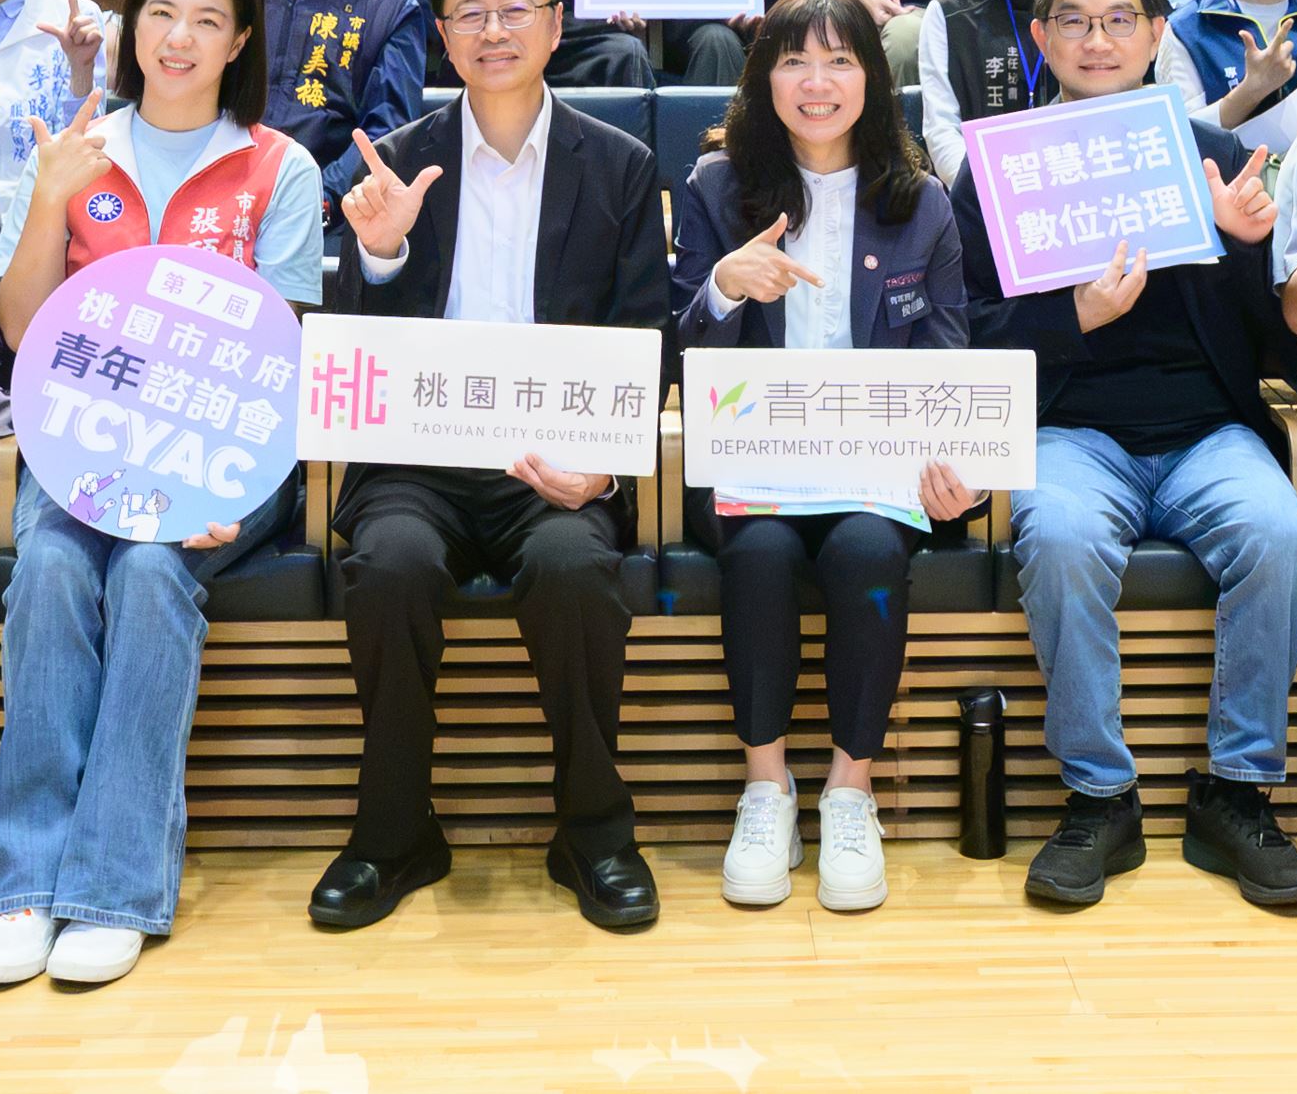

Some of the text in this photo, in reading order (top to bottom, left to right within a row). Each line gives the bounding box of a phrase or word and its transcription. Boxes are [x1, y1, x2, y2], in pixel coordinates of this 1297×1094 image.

[294, 11, 339, 108] 陳美梅
[338, 15, 366, 71] 市議員
[1001, 125, 1174, 195] 智慧生活
[233, 191, 257, 265] 市議員
[1014, 183, 1192, 255] 數位治理
[161, 270, 248, 319] 第7屆
[77, 287, 296, 394] 桃園市政府
[49, 330, 284, 446] 青年諮詢會
[412, 371, 647, 419] 桃園市政府
[763, 380, 1011, 427] 青年事務局
[39, 378, 258, 500] TCYAC
[412, 422, 645, 445] TAOYUAN CITY GOVERNMENT
[710, 439, 1011, 458] DEPARTMENT OF YOUTH AFFAIRS
